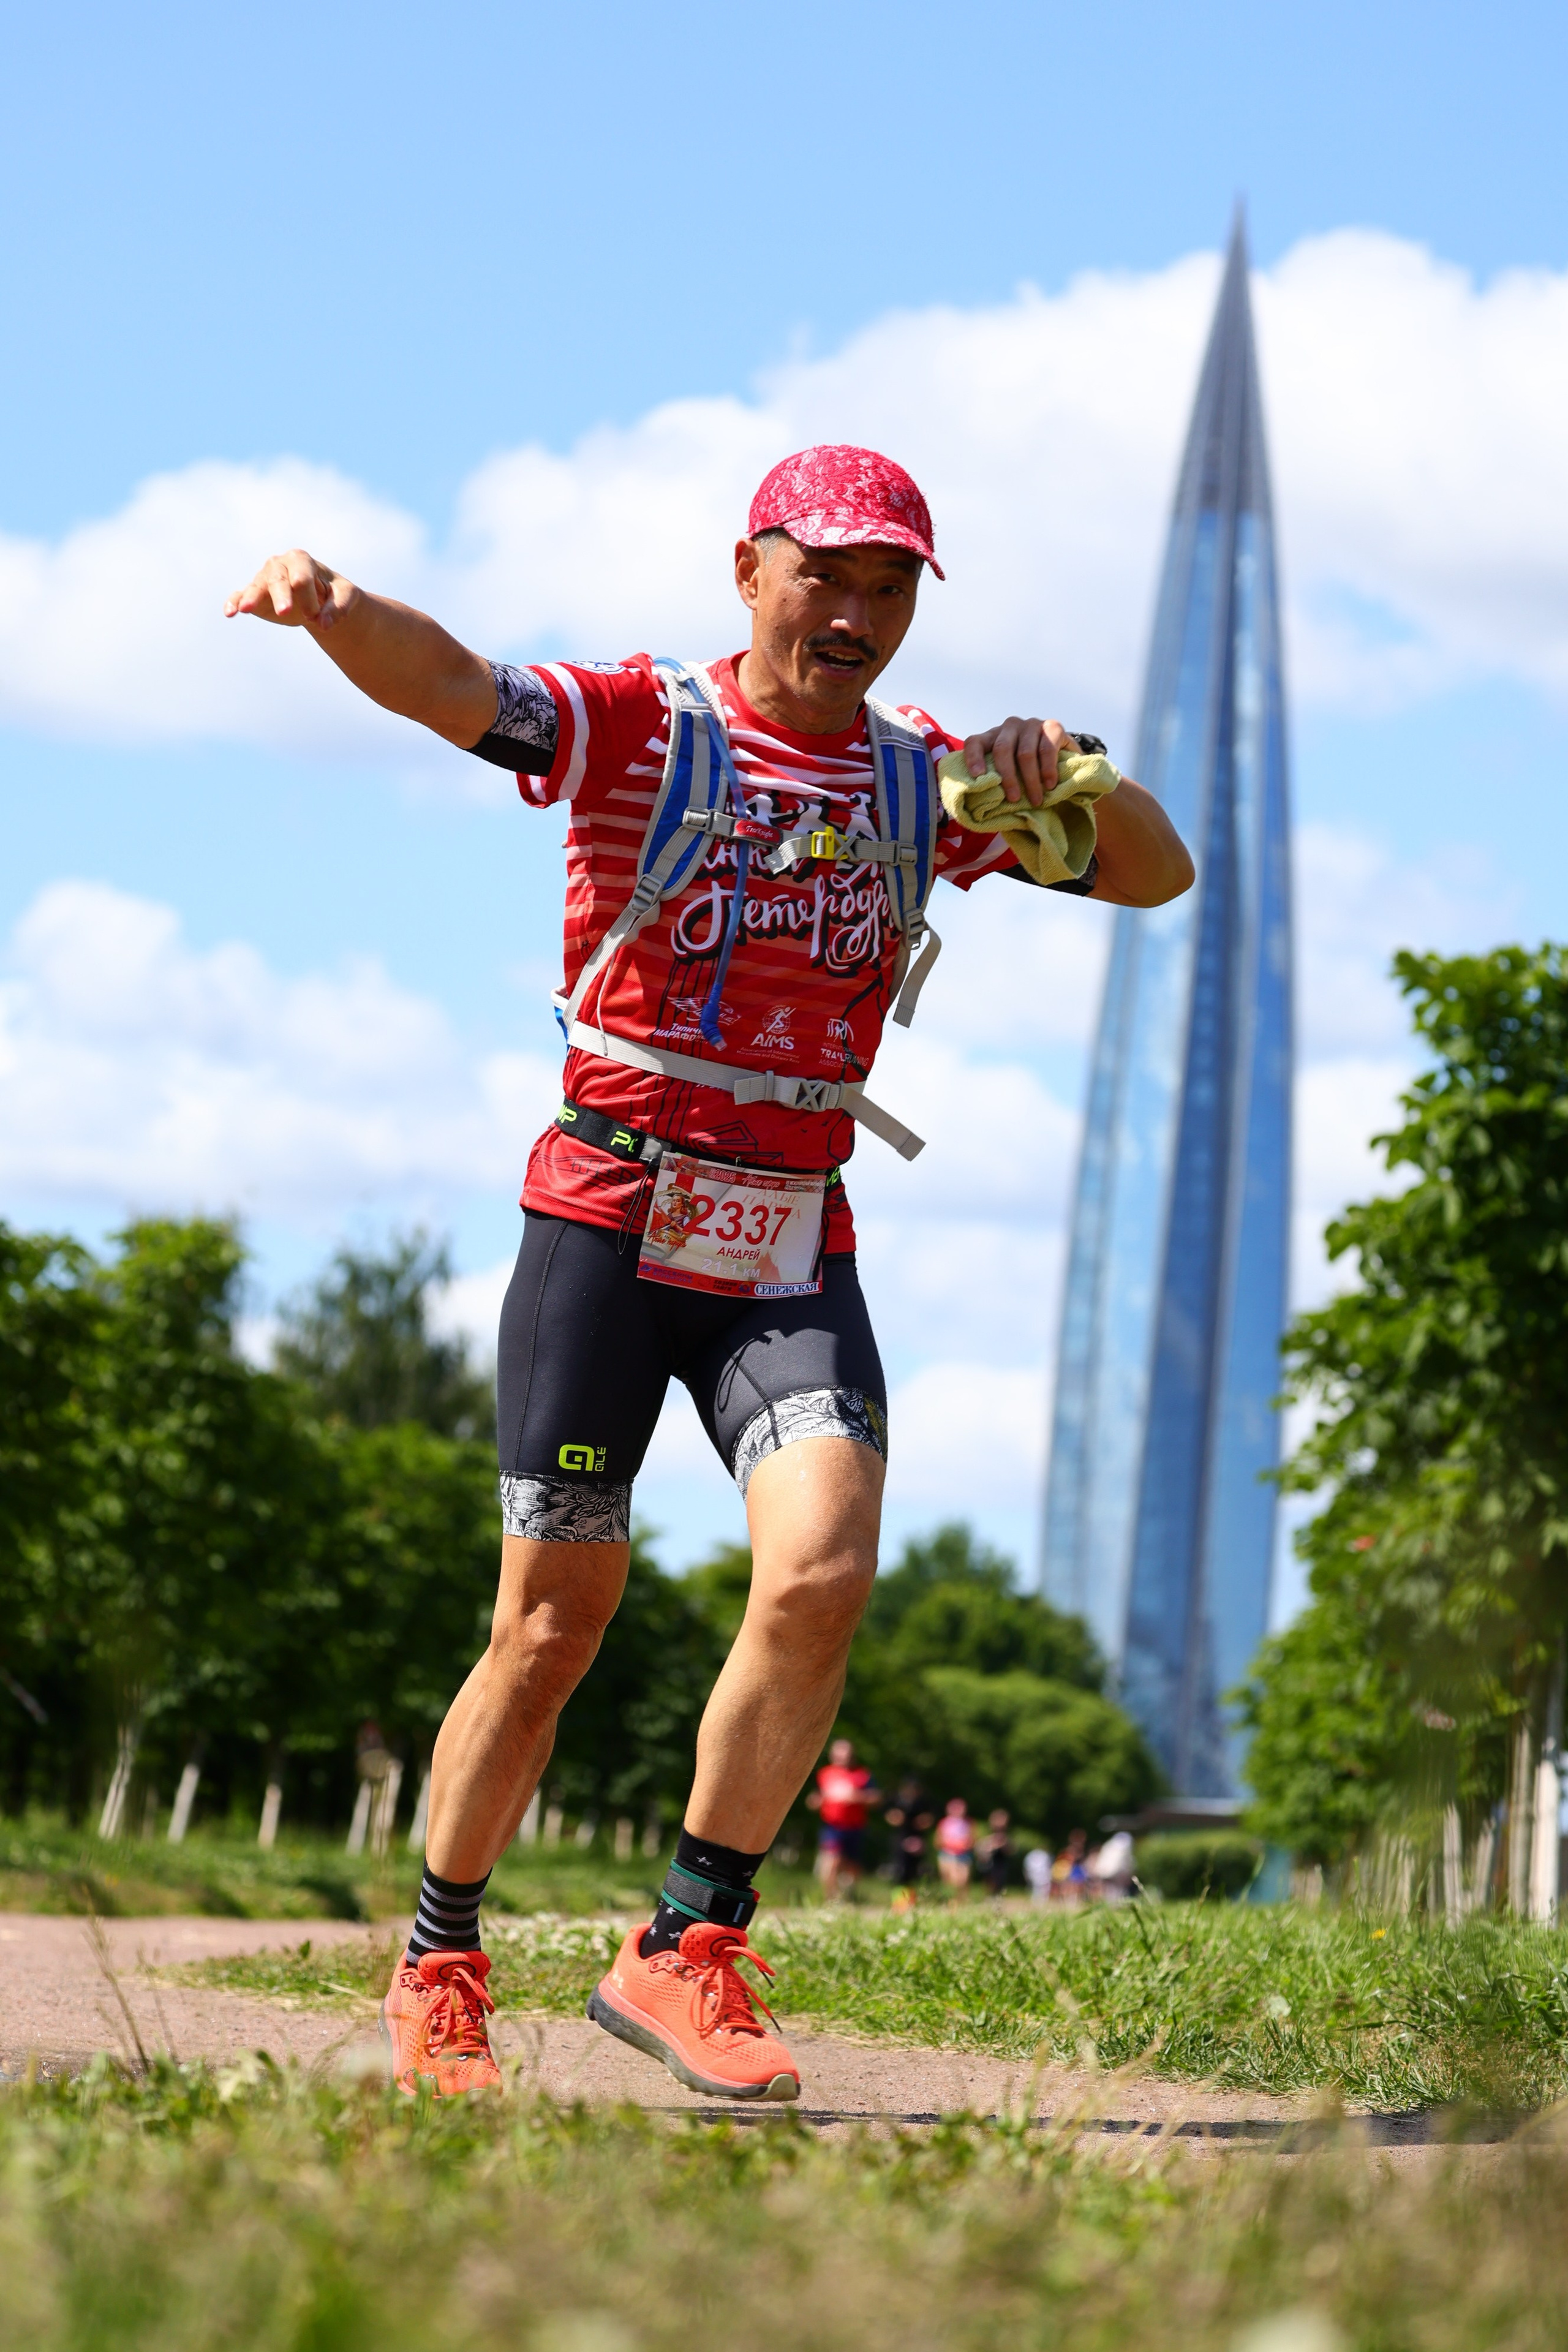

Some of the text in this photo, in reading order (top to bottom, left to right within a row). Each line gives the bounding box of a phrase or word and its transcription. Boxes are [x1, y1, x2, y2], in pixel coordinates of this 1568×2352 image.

[671, 861, 894, 970] Петербур
[750, 1033, 795, 1050] AIMS
[742, 1195, 801, 1219] ПАРА
[682, 1194, 792, 1246] 2337
[717, 1246, 761, 1261] АНДРЕЙ
[701, 1258, 737, 1276] 21.1
[756, 1283, 818, 1295] СЕНЕЖСКАЯ
